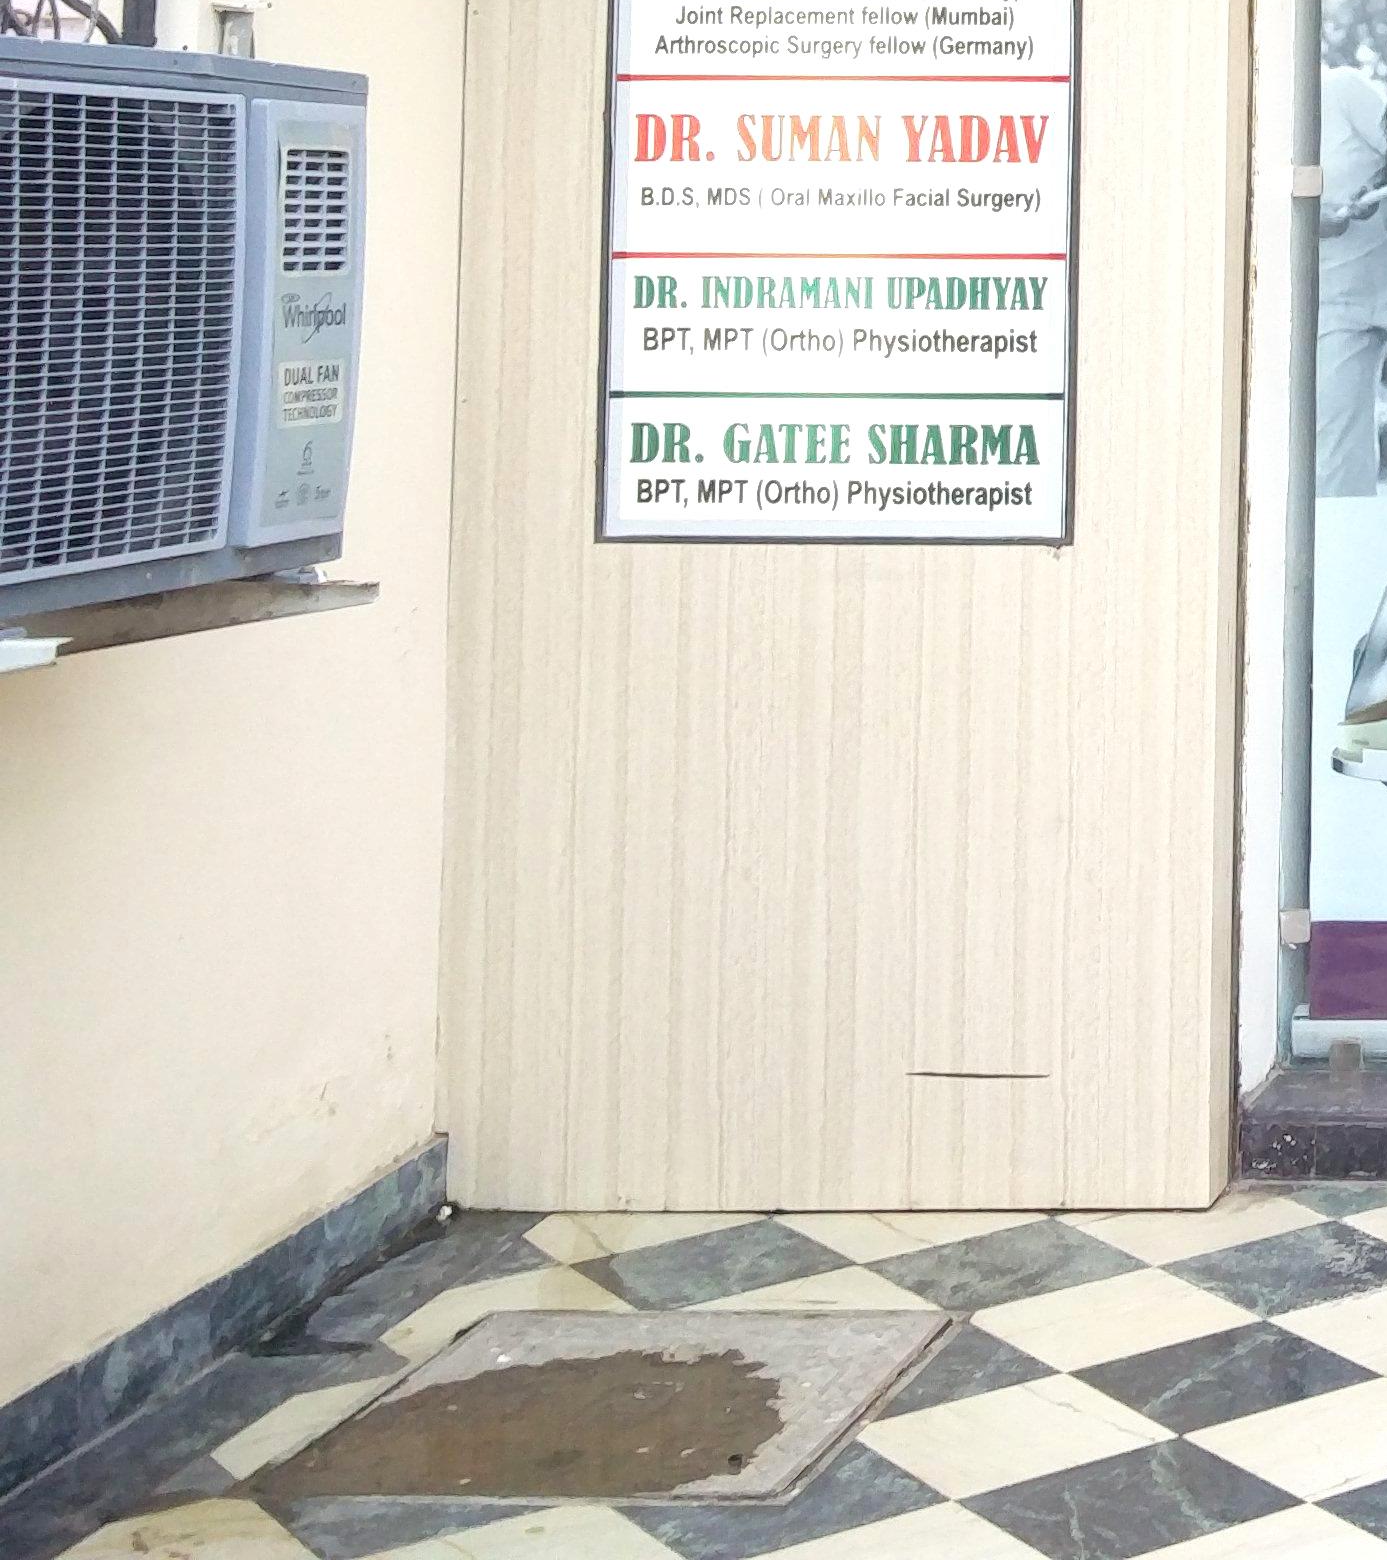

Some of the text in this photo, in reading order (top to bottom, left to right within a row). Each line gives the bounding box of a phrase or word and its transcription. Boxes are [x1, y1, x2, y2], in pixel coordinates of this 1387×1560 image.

[675, 6, 1014, 30] Joint Replacement fellow (Mumbai)
[654, 35, 1034, 59] Arthroscopic Surgery fellow (Germany)
[634, 113, 1049, 163] DR. SUMAN YADAV
[707, 188, 750, 206] MDS
[818, 187, 885, 207] Maxillo
[893, 188, 949, 207] Facial
[957, 189, 1041, 212] Surgery)
[633, 275, 1049, 310] DR. INDRAMANI UPADHYAY
[643, 328, 1038, 358] BPT, MPT (Ortho) Physiotherapist
[284, 365, 339, 386] DUAL FAN
[629, 422, 1040, 466] DR. GATEE SHARMA
[636, 479, 1032, 511] BPT, MPT (Ortho) Physiotherapist
